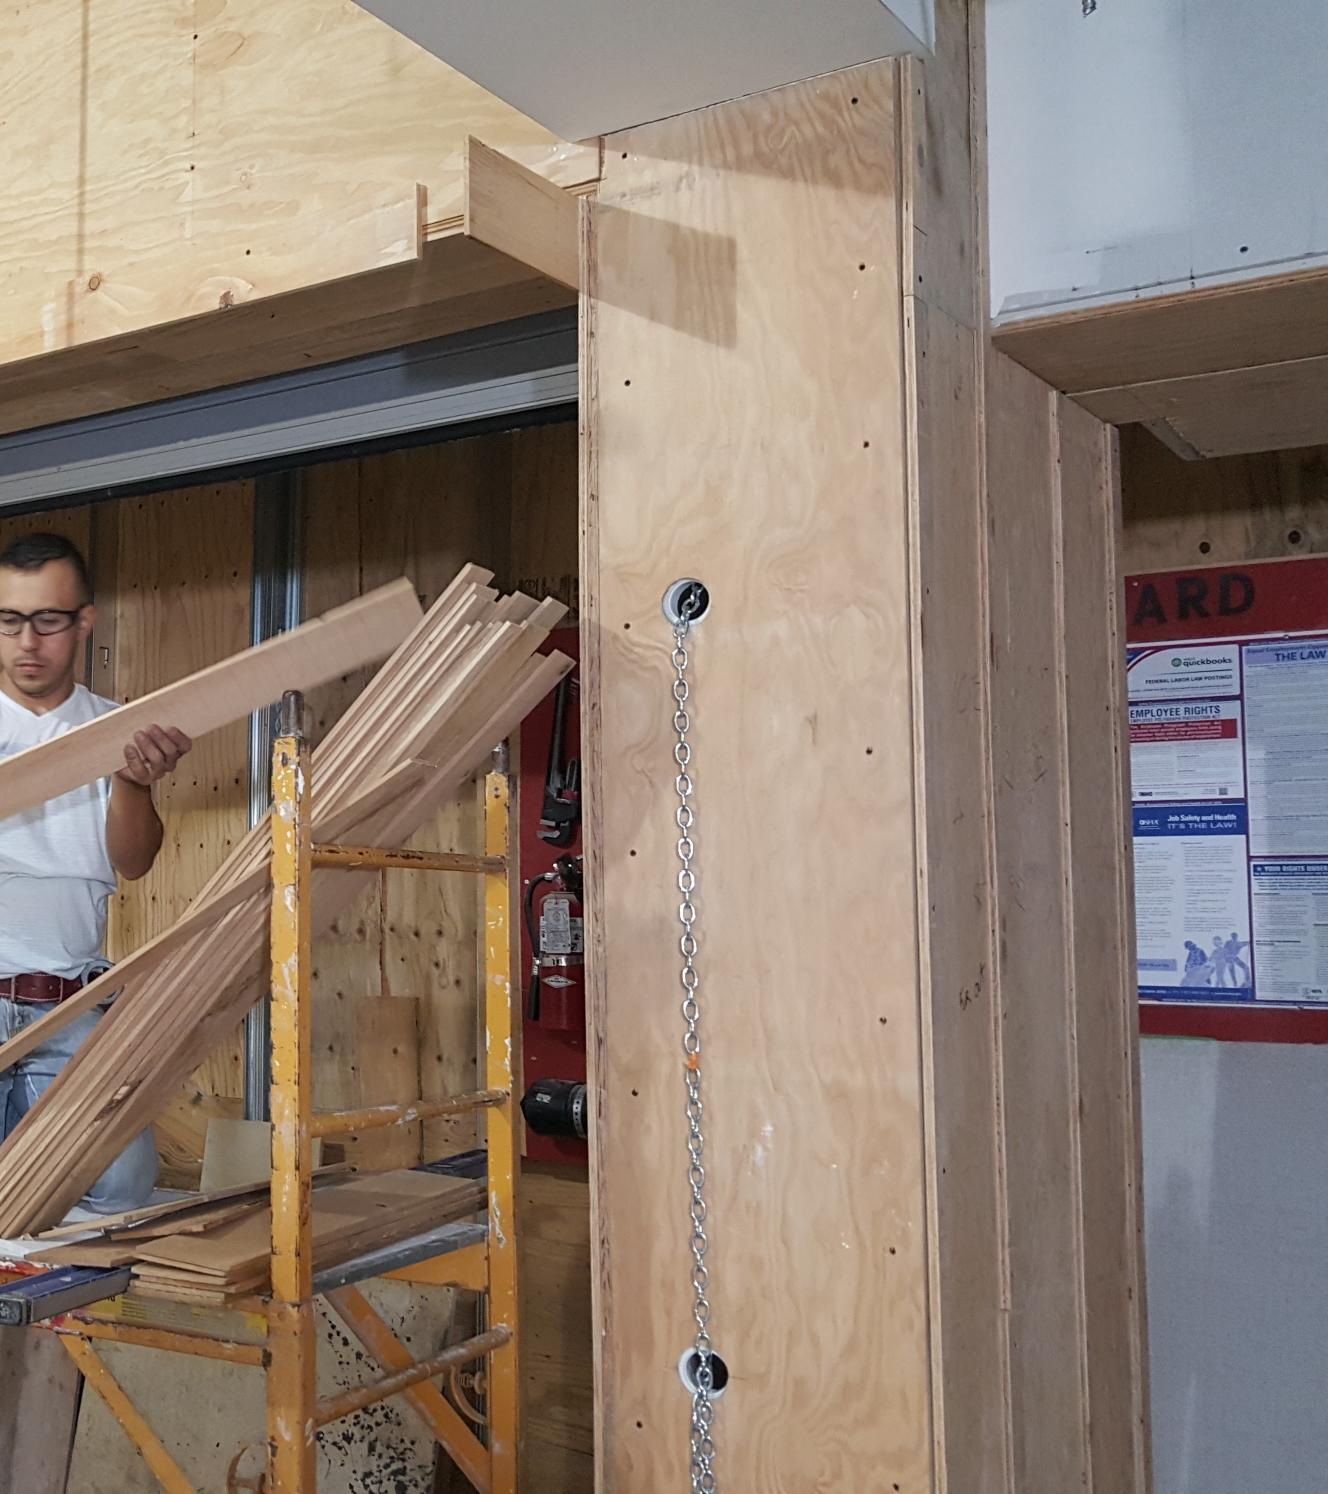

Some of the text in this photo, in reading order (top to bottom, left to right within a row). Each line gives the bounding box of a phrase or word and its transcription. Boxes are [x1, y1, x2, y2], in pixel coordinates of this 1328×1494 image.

[1275, 650, 1327, 661] THE LAW
[1183, 657, 1232, 667] quickbooks
[1130, 705, 1221, 718] EMPLOYEE RIGHTS
[1180, 814, 1201, 822] Safety
